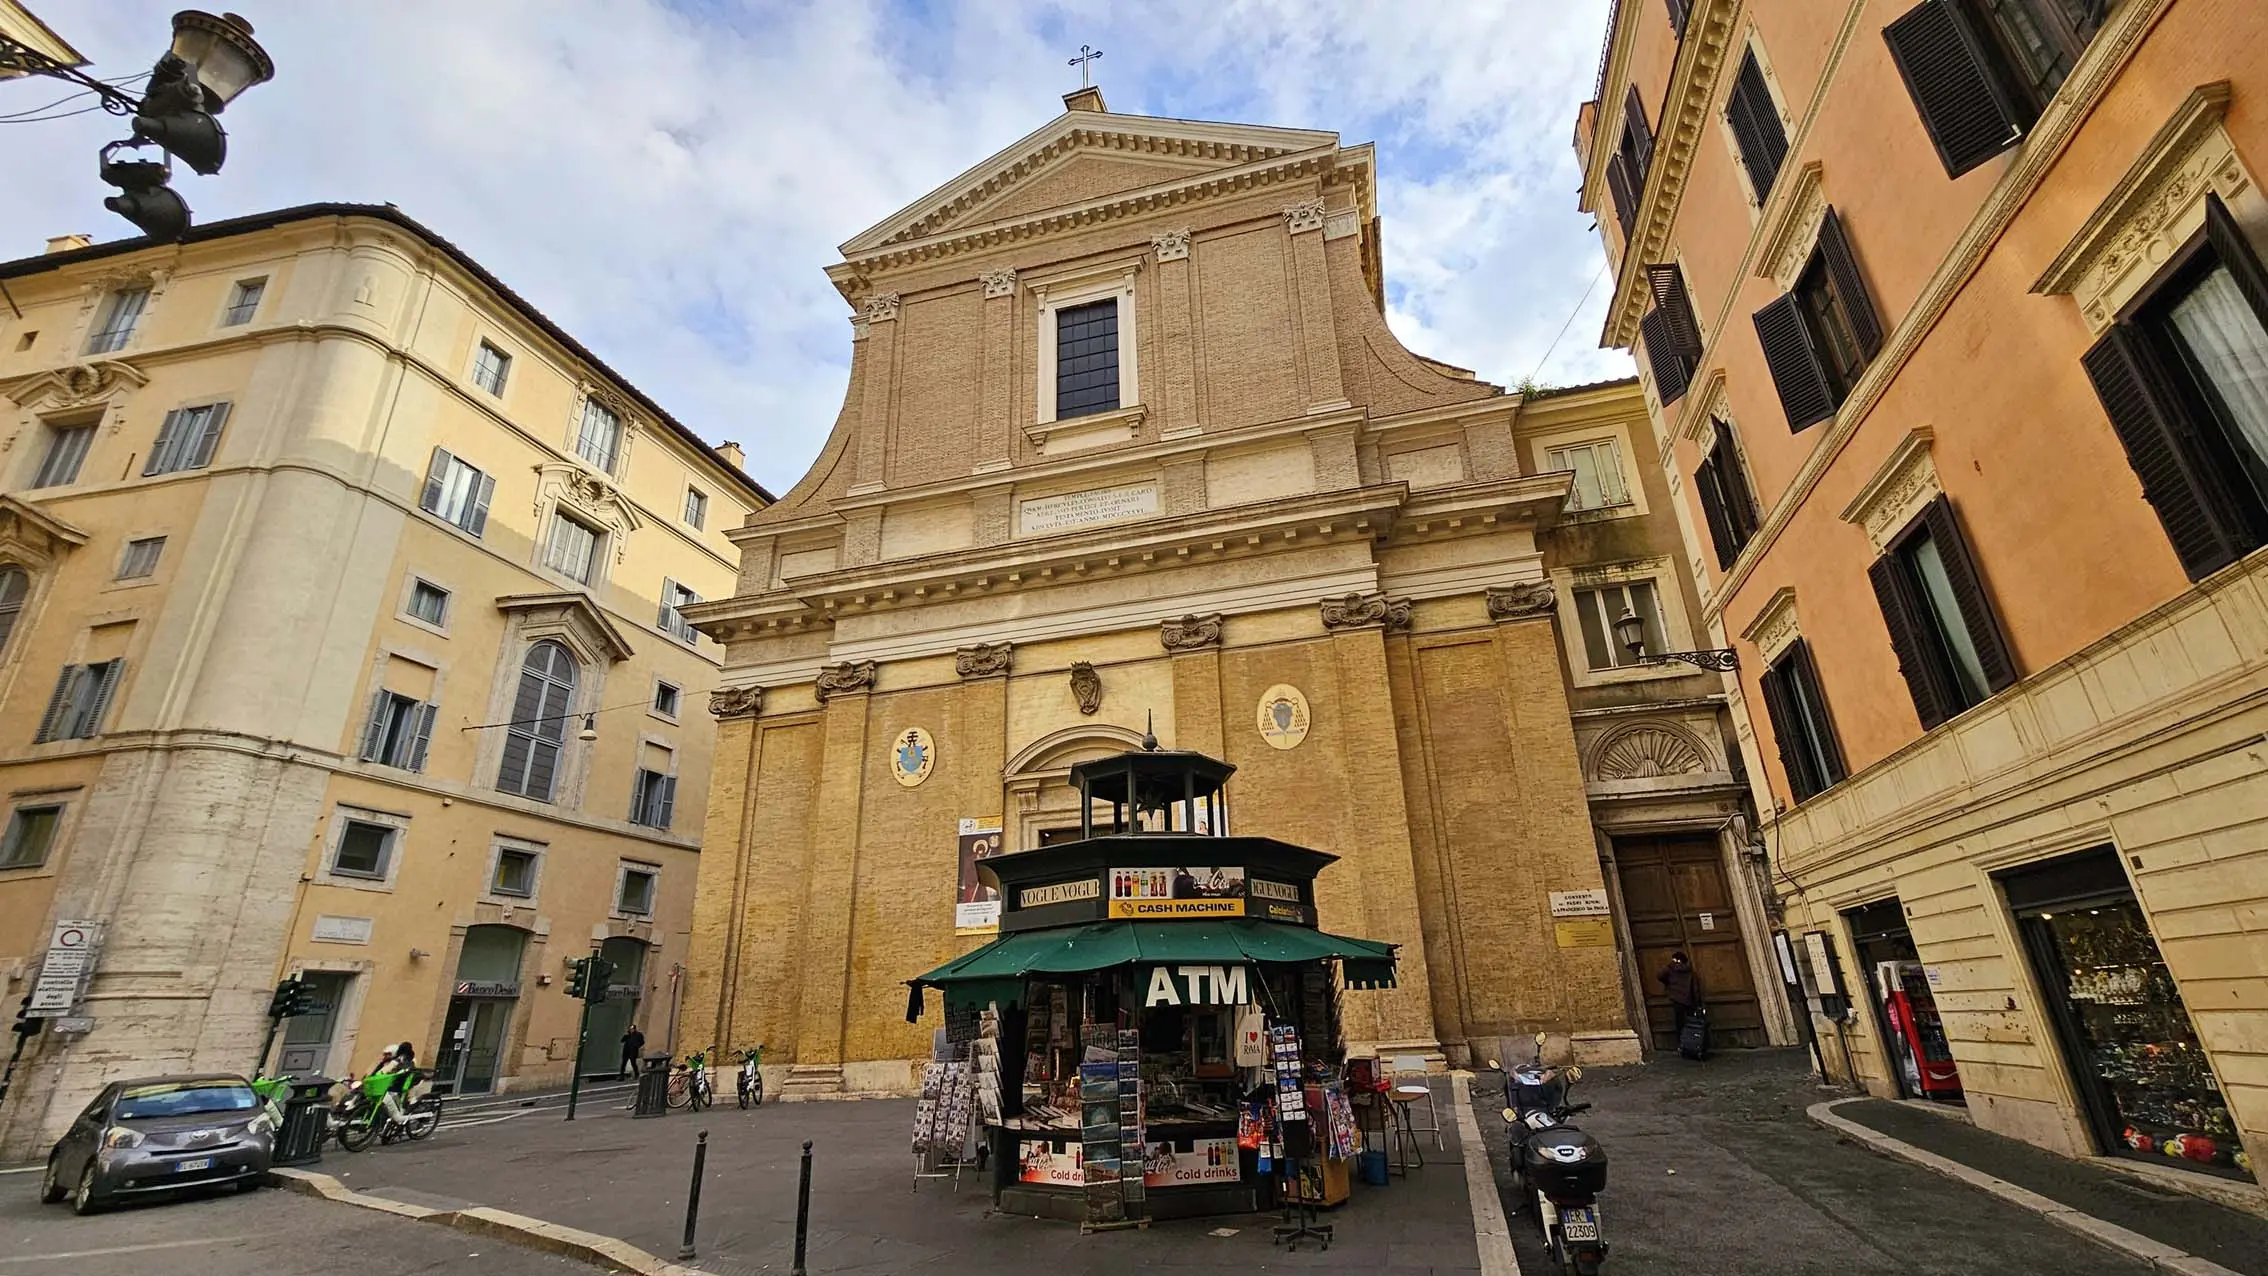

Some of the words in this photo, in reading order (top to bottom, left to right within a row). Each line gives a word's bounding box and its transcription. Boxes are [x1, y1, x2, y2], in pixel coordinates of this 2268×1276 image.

[1021, 889, 1059, 905] VOGUE
[1138, 904, 1173, 913] CASH
[1176, 903, 1235, 913] MACHINE
[1145, 965, 1248, 1008] ATM
[1245, 1031, 1249, 1044] I
[1051, 1169, 1070, 1180] Cold
[1175, 1169, 1201, 1181] Cold
[1204, 1166, 1237, 1179] drinks
[1569, 1208, 1581, 1222] ER
[1567, 1224, 1596, 1238] 22309
